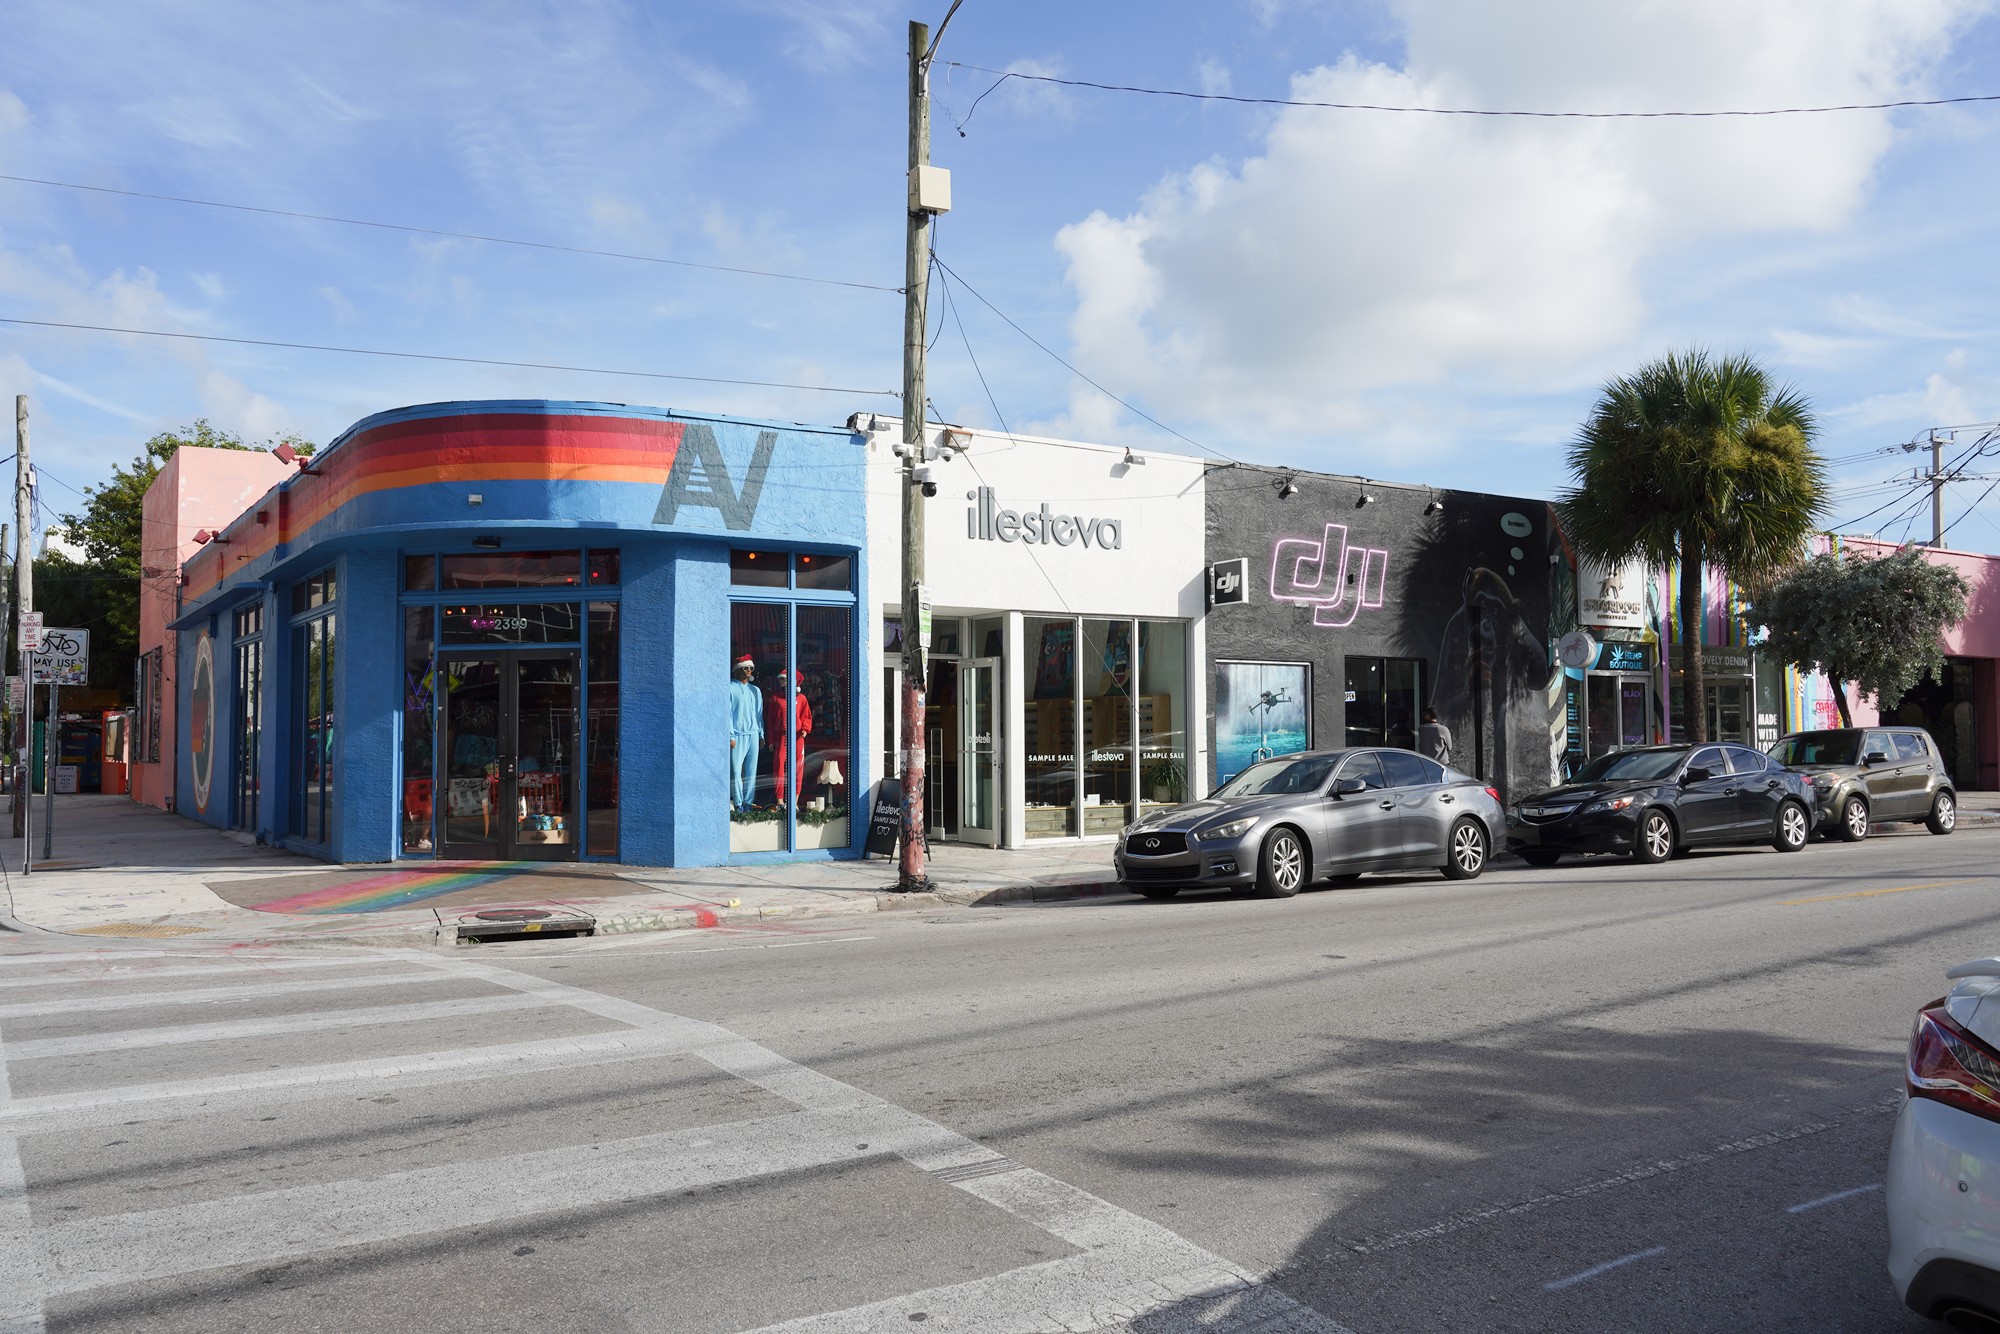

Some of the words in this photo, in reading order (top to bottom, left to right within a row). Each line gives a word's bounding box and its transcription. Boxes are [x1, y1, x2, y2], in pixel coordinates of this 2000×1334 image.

[651, 424, 778, 531] AV
[966, 486, 1122, 550] illesteva
[1270, 523, 1388, 626] dji
[1216, 572, 1240, 593] dji
[494, 618, 528, 630] 2399
[1624, 651, 1642, 660] HEMP
[1701, 655, 1722, 666] OVELY
[1724, 655, 1748, 667] DENIM
[34, 658, 53, 667] MAY
[57, 658, 76, 668] USE
[1609, 660, 1642, 670] BOUTIQUE
[1623, 690, 1642, 698] BLACK
[1758, 714, 1777, 726] MADE
[1758, 728, 1777, 740] WITH
[1758, 741, 1776, 754] LOV
[1028, 754, 1056, 762] SAMPLE
[1057, 754, 1074, 762] SALE
[1091, 750, 1125, 762] illesteva
[873, 815, 890, 824] SAMPLE
[889, 817, 899, 825] SALE
